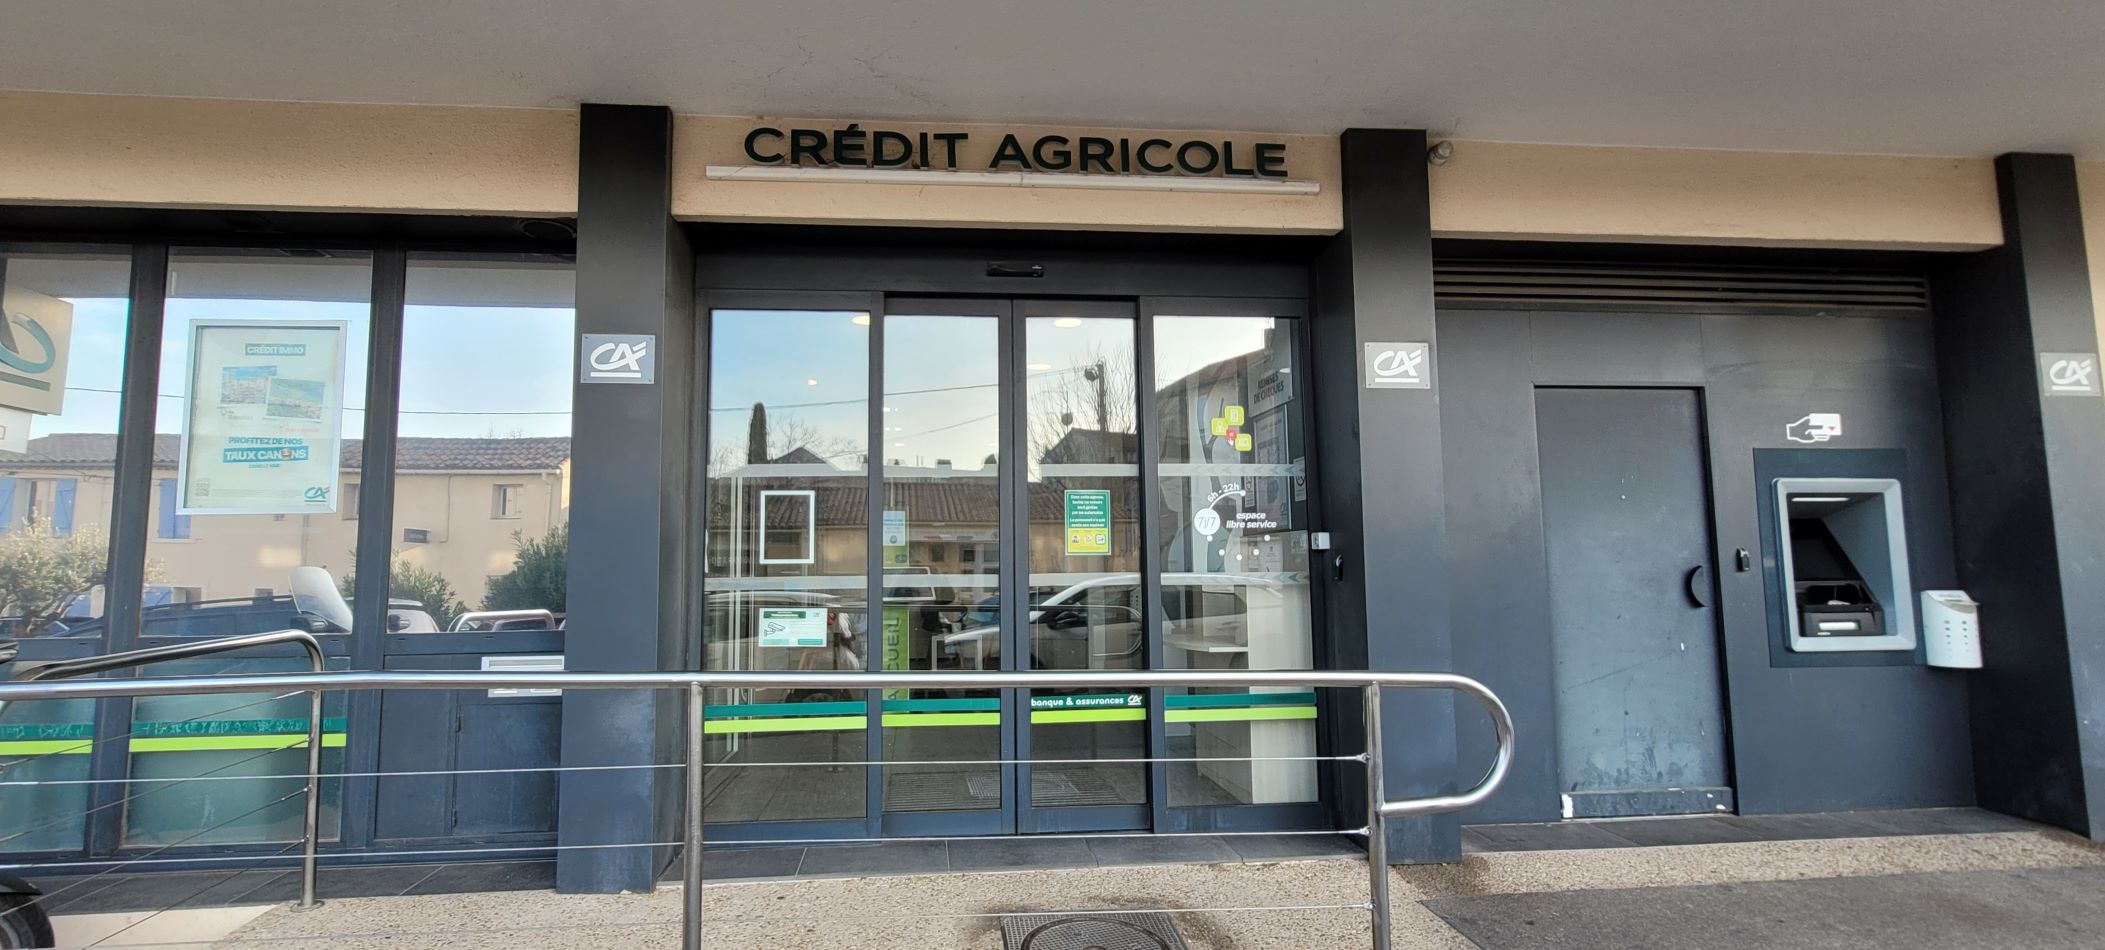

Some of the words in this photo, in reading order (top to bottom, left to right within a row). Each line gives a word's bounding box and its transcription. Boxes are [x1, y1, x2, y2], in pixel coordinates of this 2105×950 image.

[744, 123, 968, 169] CRÉDIT
[988, 133, 1288, 178] AGRICOLE
[228, 436, 271, 445] PROFITEZ
[272, 437, 284, 445] DE
[225, 450, 257, 461] TAUX
[1207, 491, 1219, 503] 6h
[1222, 482, 1240, 493] 22h
[1236, 512, 1267, 521] espace
[1226, 520, 1246, 529] libre
[1246, 519, 1278, 529] service
[887, 616, 900, 701] ACUEIL
[1031, 697, 1064, 708] banque
[1065, 697, 1074, 706] &
[1075, 697, 1124, 706] assurances
